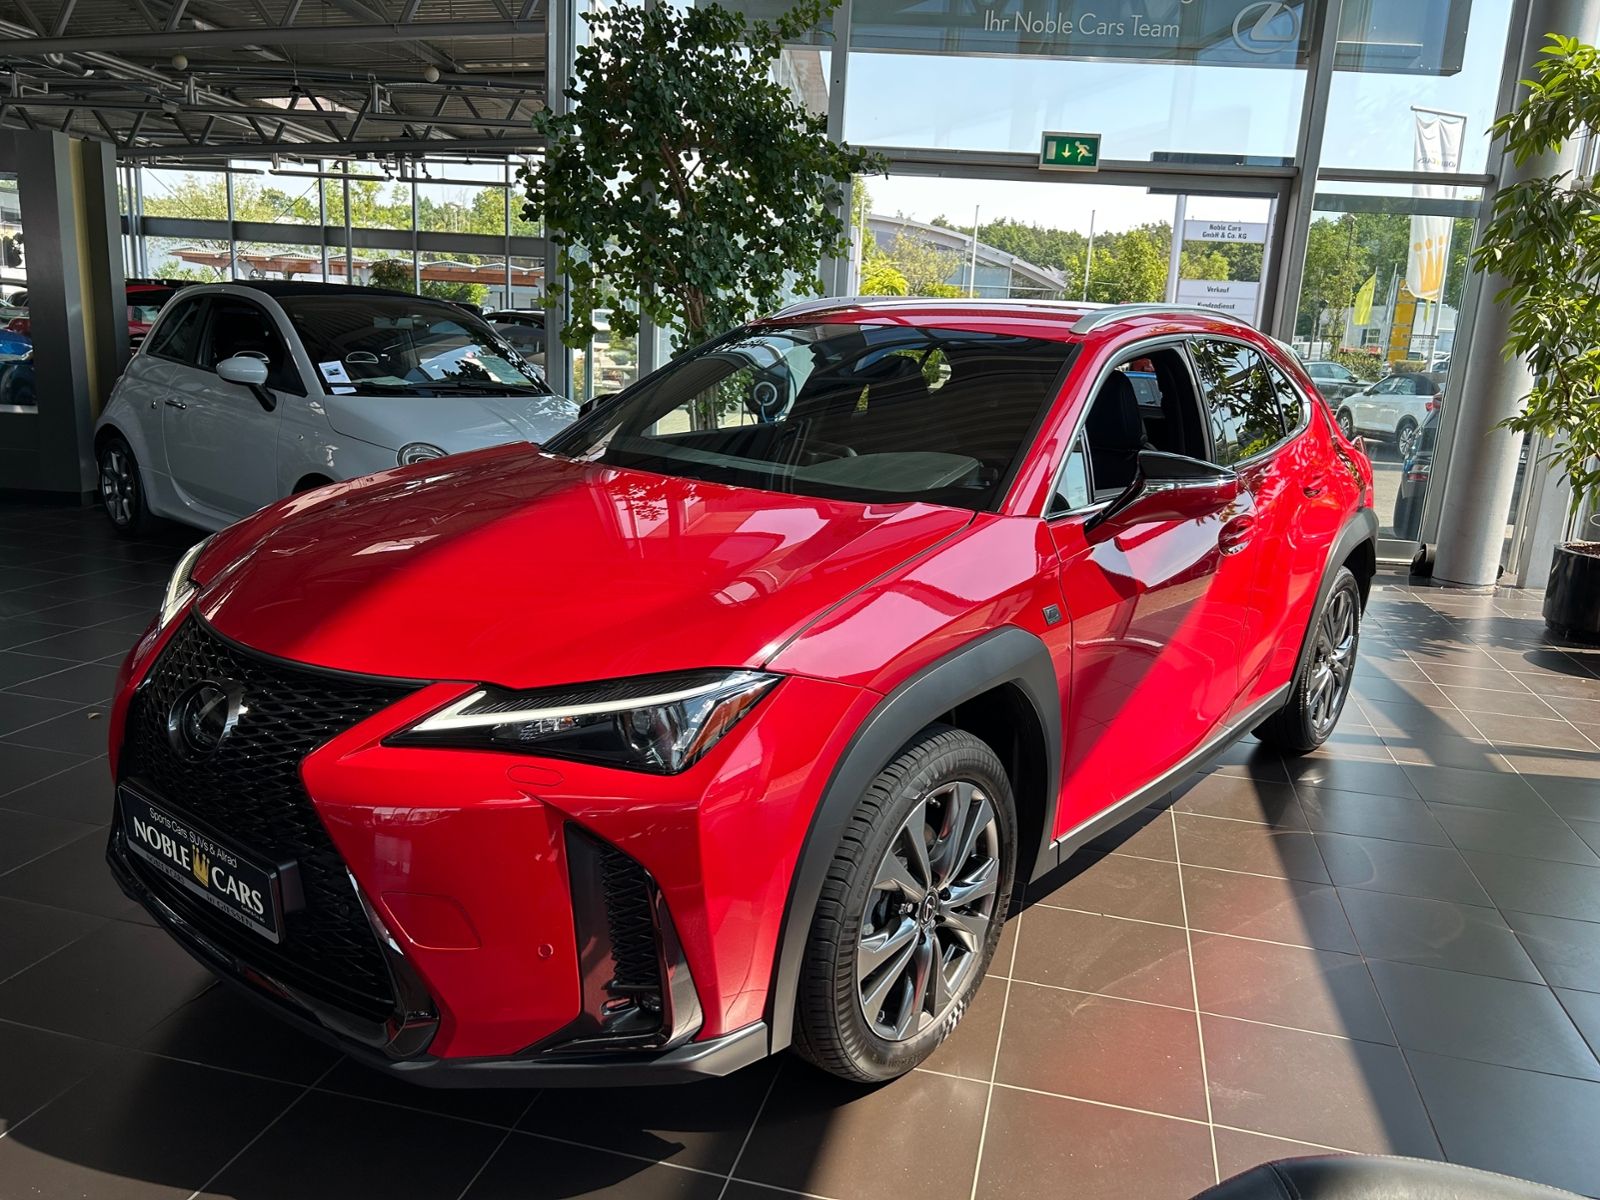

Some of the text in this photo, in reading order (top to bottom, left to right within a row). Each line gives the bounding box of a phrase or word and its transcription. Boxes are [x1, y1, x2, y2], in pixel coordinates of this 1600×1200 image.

[984, 9, 1180, 38] Ihr Noble Cars Team
[133, 815, 192, 872] NOBLE
[211, 865, 264, 916] CARS
[149, 807, 171, 829] Sports
[189, 830, 209, 852] SUVs
[209, 843, 215, 856] &
[216, 848, 238, 869] Allrad
